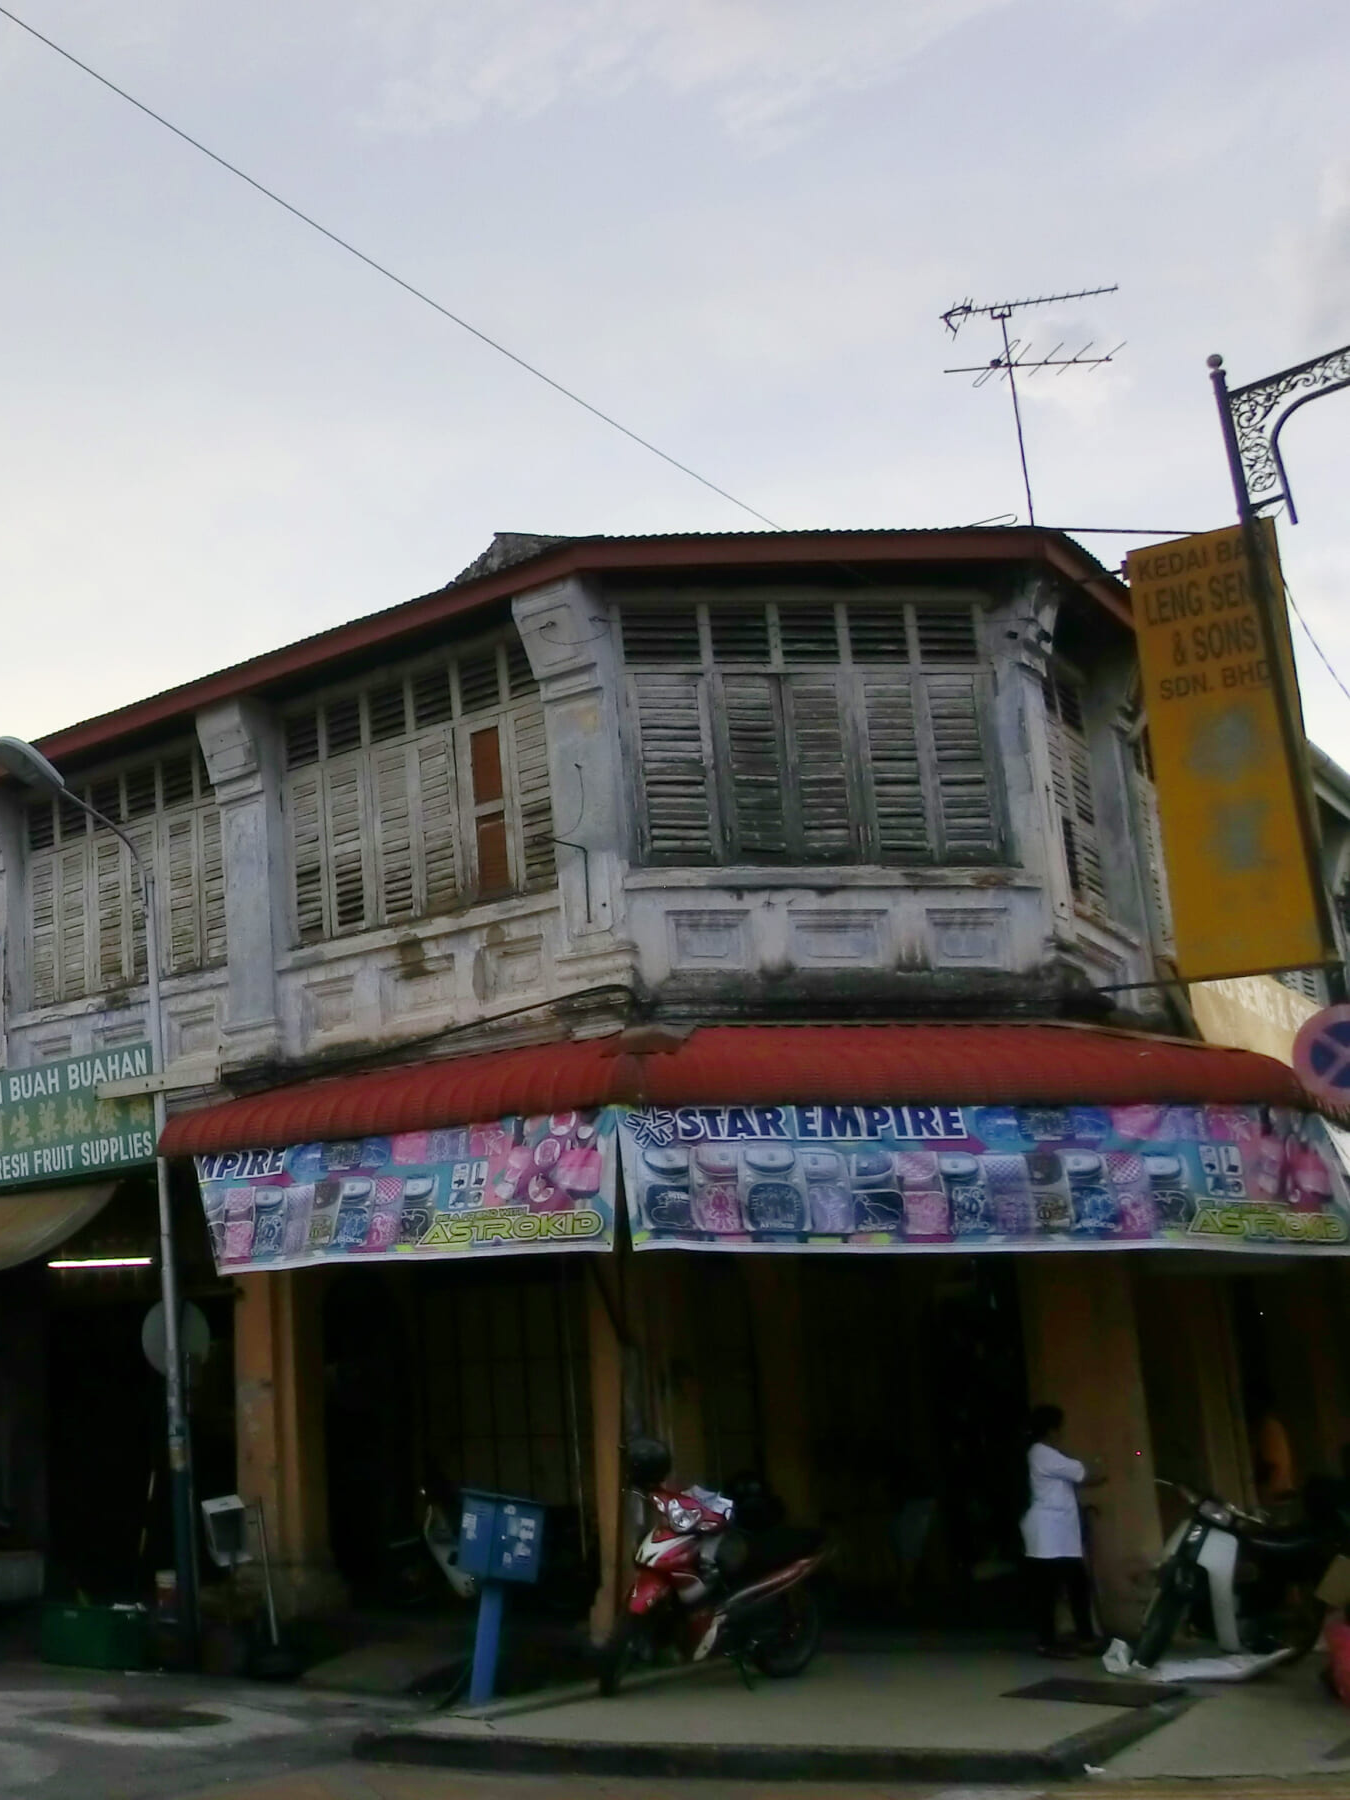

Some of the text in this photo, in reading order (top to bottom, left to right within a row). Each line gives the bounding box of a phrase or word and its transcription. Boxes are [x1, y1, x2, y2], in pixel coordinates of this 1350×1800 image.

[1137, 547, 1209, 581] KEDAI
[1143, 571, 1256, 627] LENG SEN
[1172, 615, 1258, 667] & SONS
[1160, 672, 1213, 700] SDN.
[9, 1067, 59, 1102] BUAH
[67, 1048, 148, 1090] BUAHAN
[675, 1106, 968, 1140] STAR EMPIRE
[33, 1145, 75, 1174] FRUIT
[81, 1131, 153, 1166] SUPPLIES
[418, 1210, 604, 1246] ASTROKID
